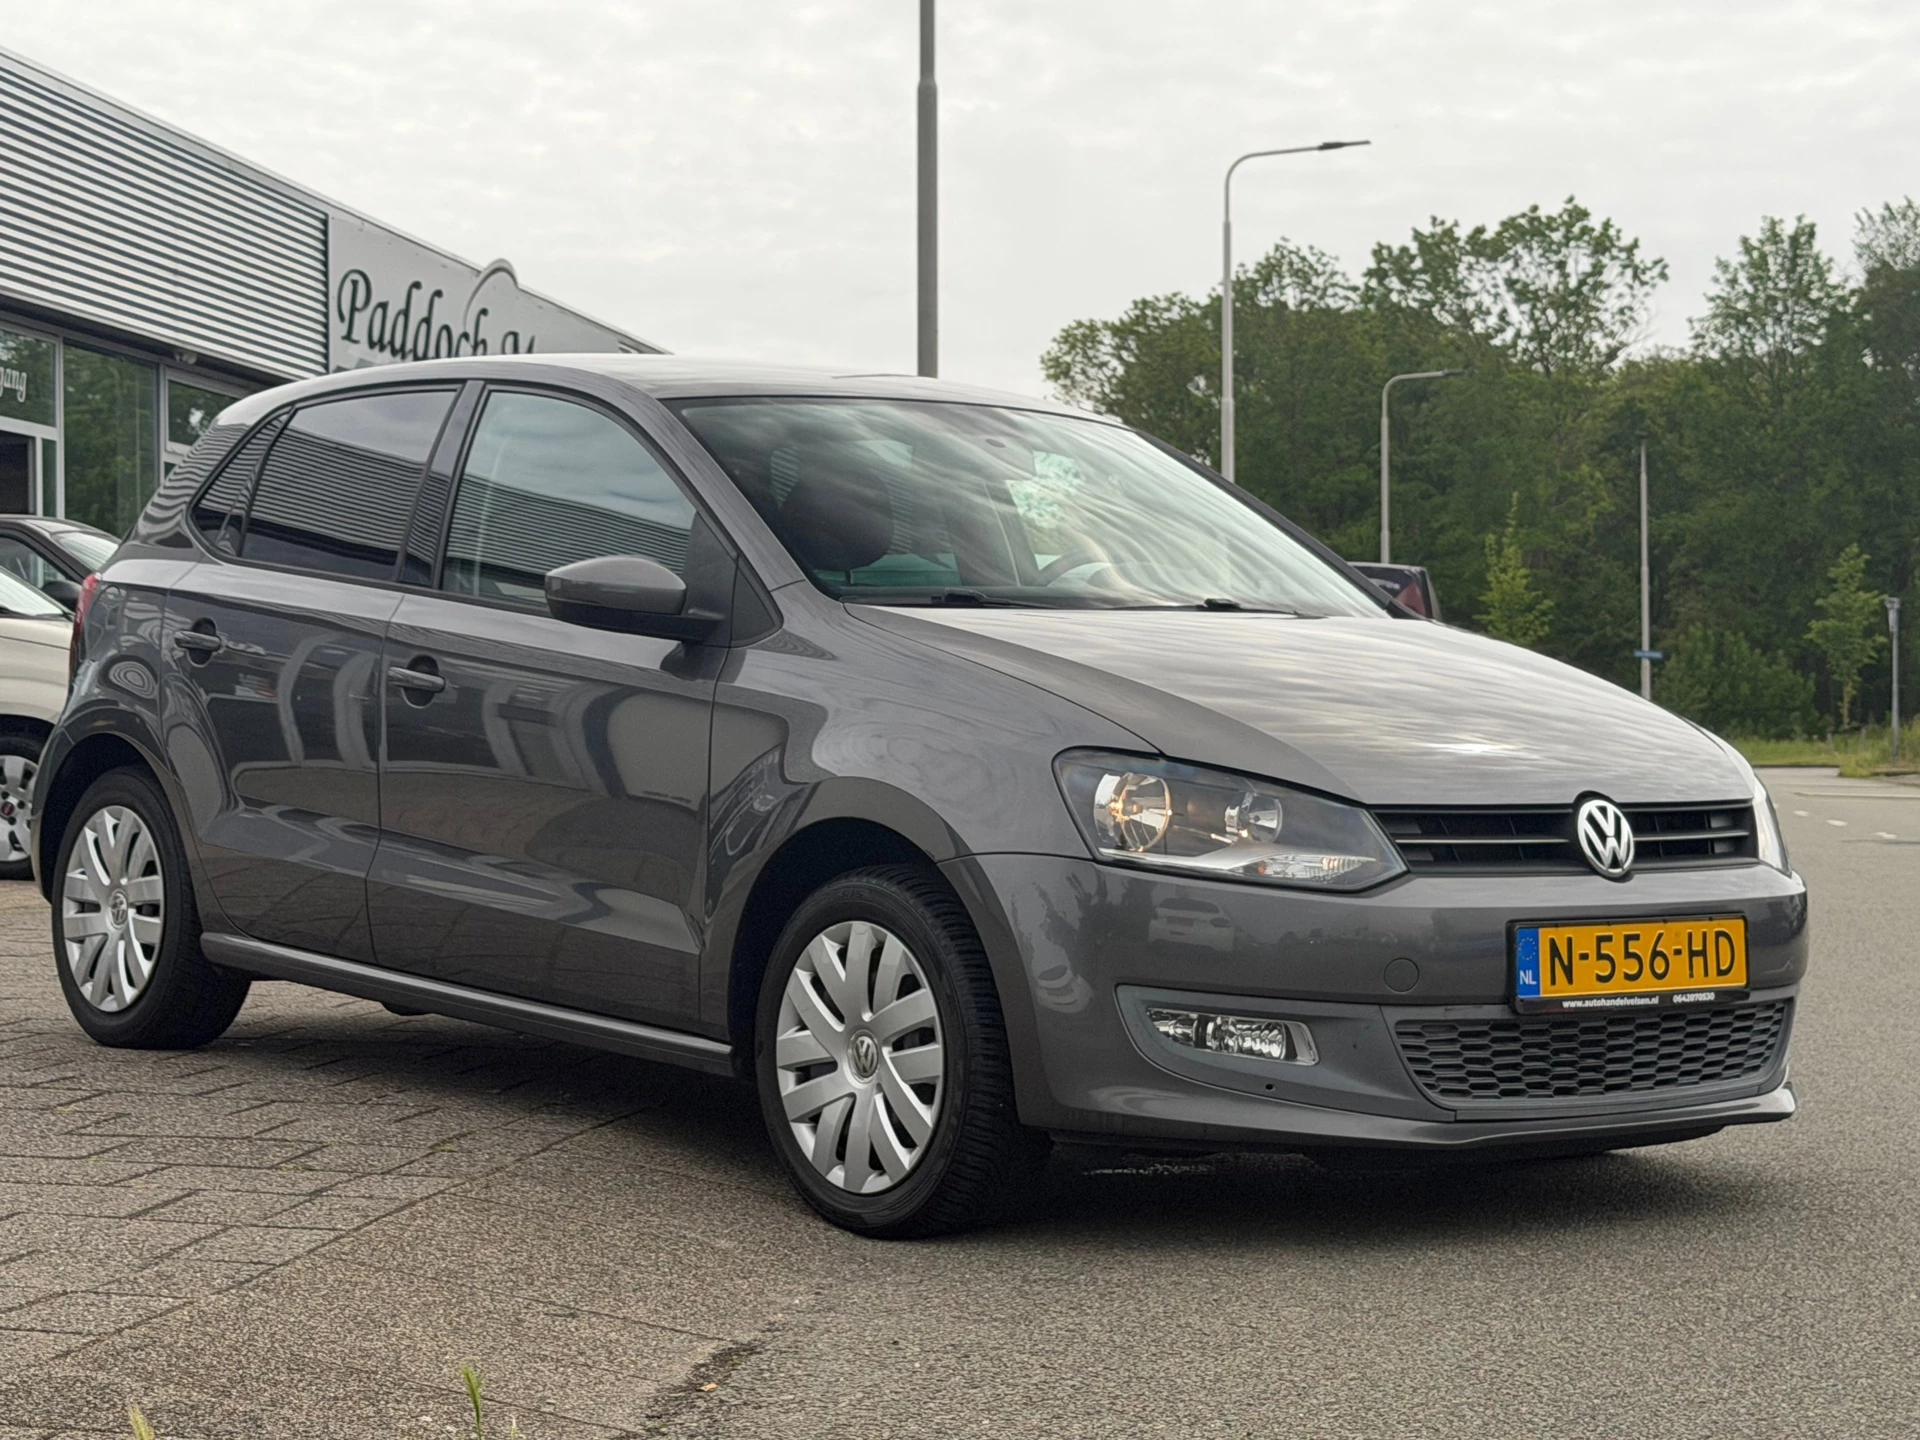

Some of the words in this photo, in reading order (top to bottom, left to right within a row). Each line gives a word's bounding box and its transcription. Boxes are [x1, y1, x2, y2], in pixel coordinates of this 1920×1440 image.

[1578, 800, 1634, 876] VW
[1519, 970, 1537, 985] NL
[1549, 929, 1735, 986] N-556-HD
